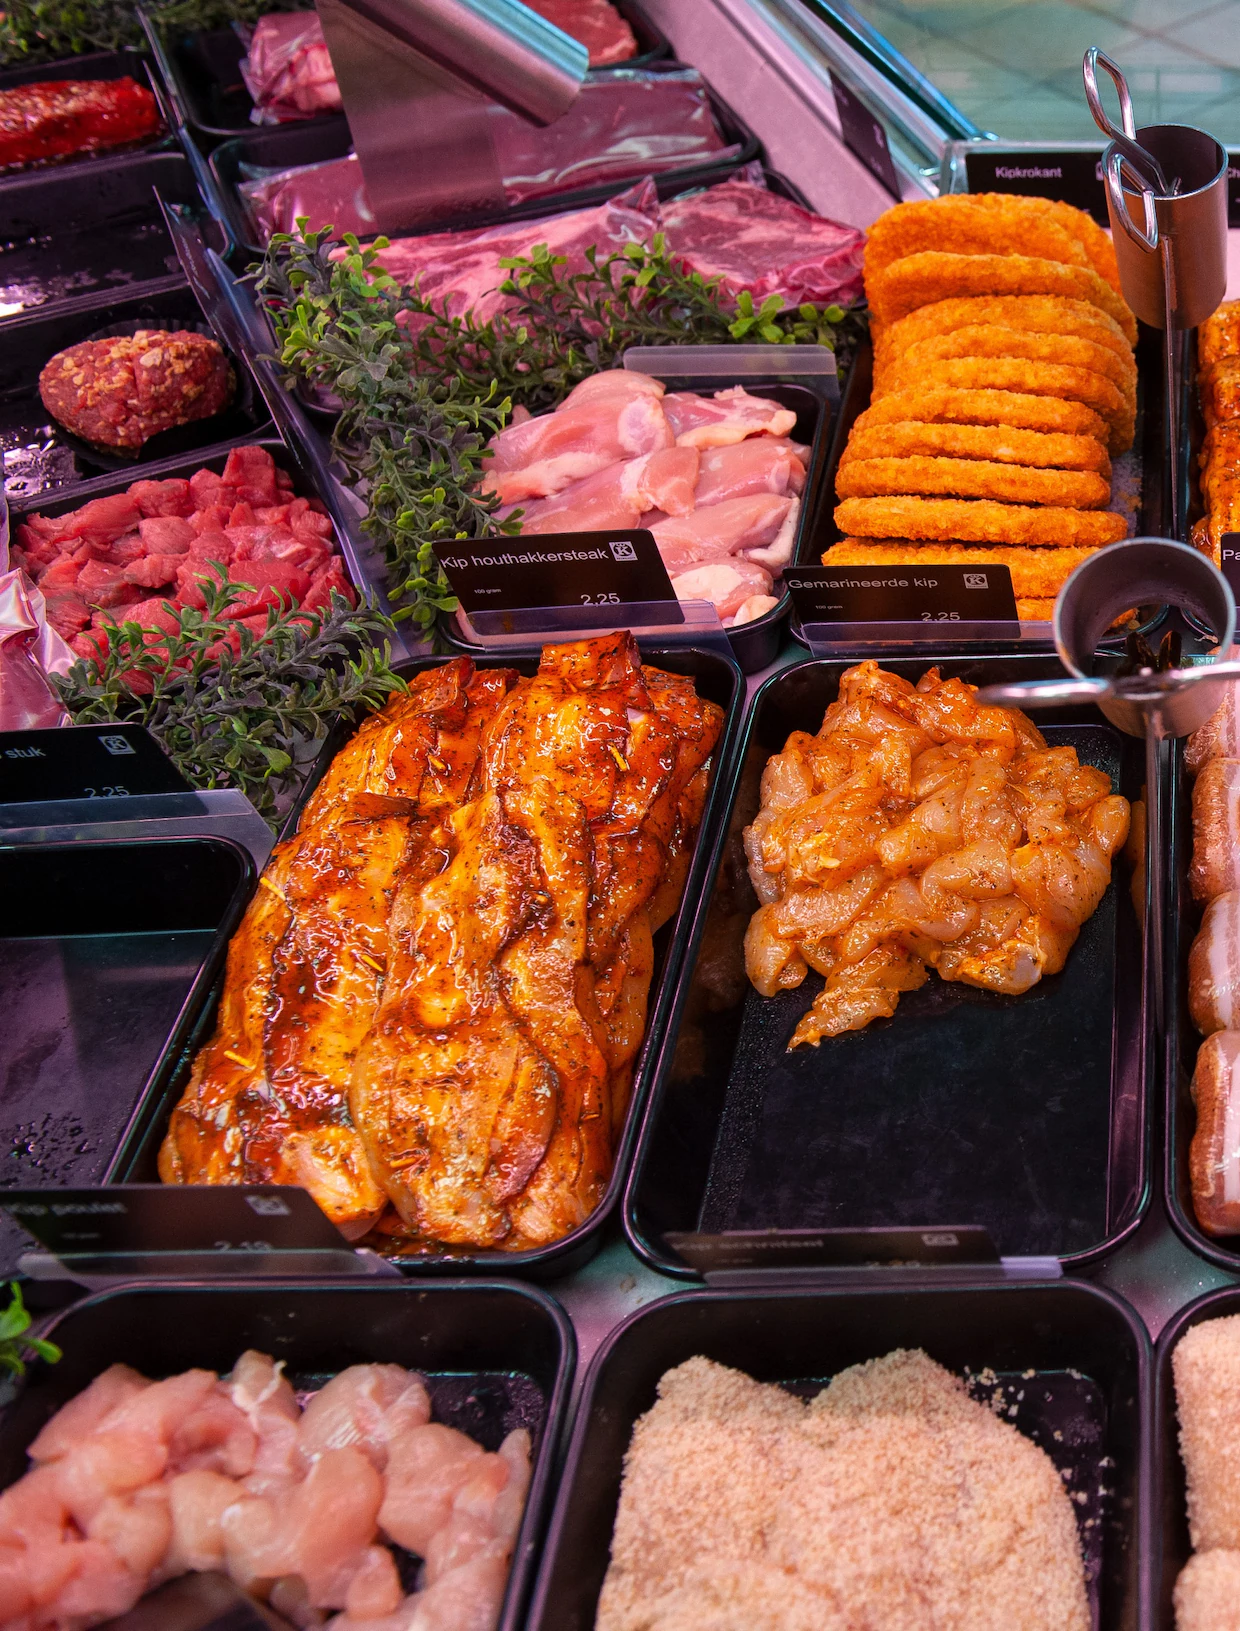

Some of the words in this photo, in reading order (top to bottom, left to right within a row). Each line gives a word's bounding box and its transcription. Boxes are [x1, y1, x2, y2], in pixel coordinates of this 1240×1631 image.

[995, 166, 1063, 179] Kipkrokant
[440, 556, 468, 570] Kip
[471, 548, 609, 567] houthakkersteak
[788, 578, 909, 589] Gemarineerde
[914, 577, 938, 588] kip
[5, 747, 46, 759] stuk
